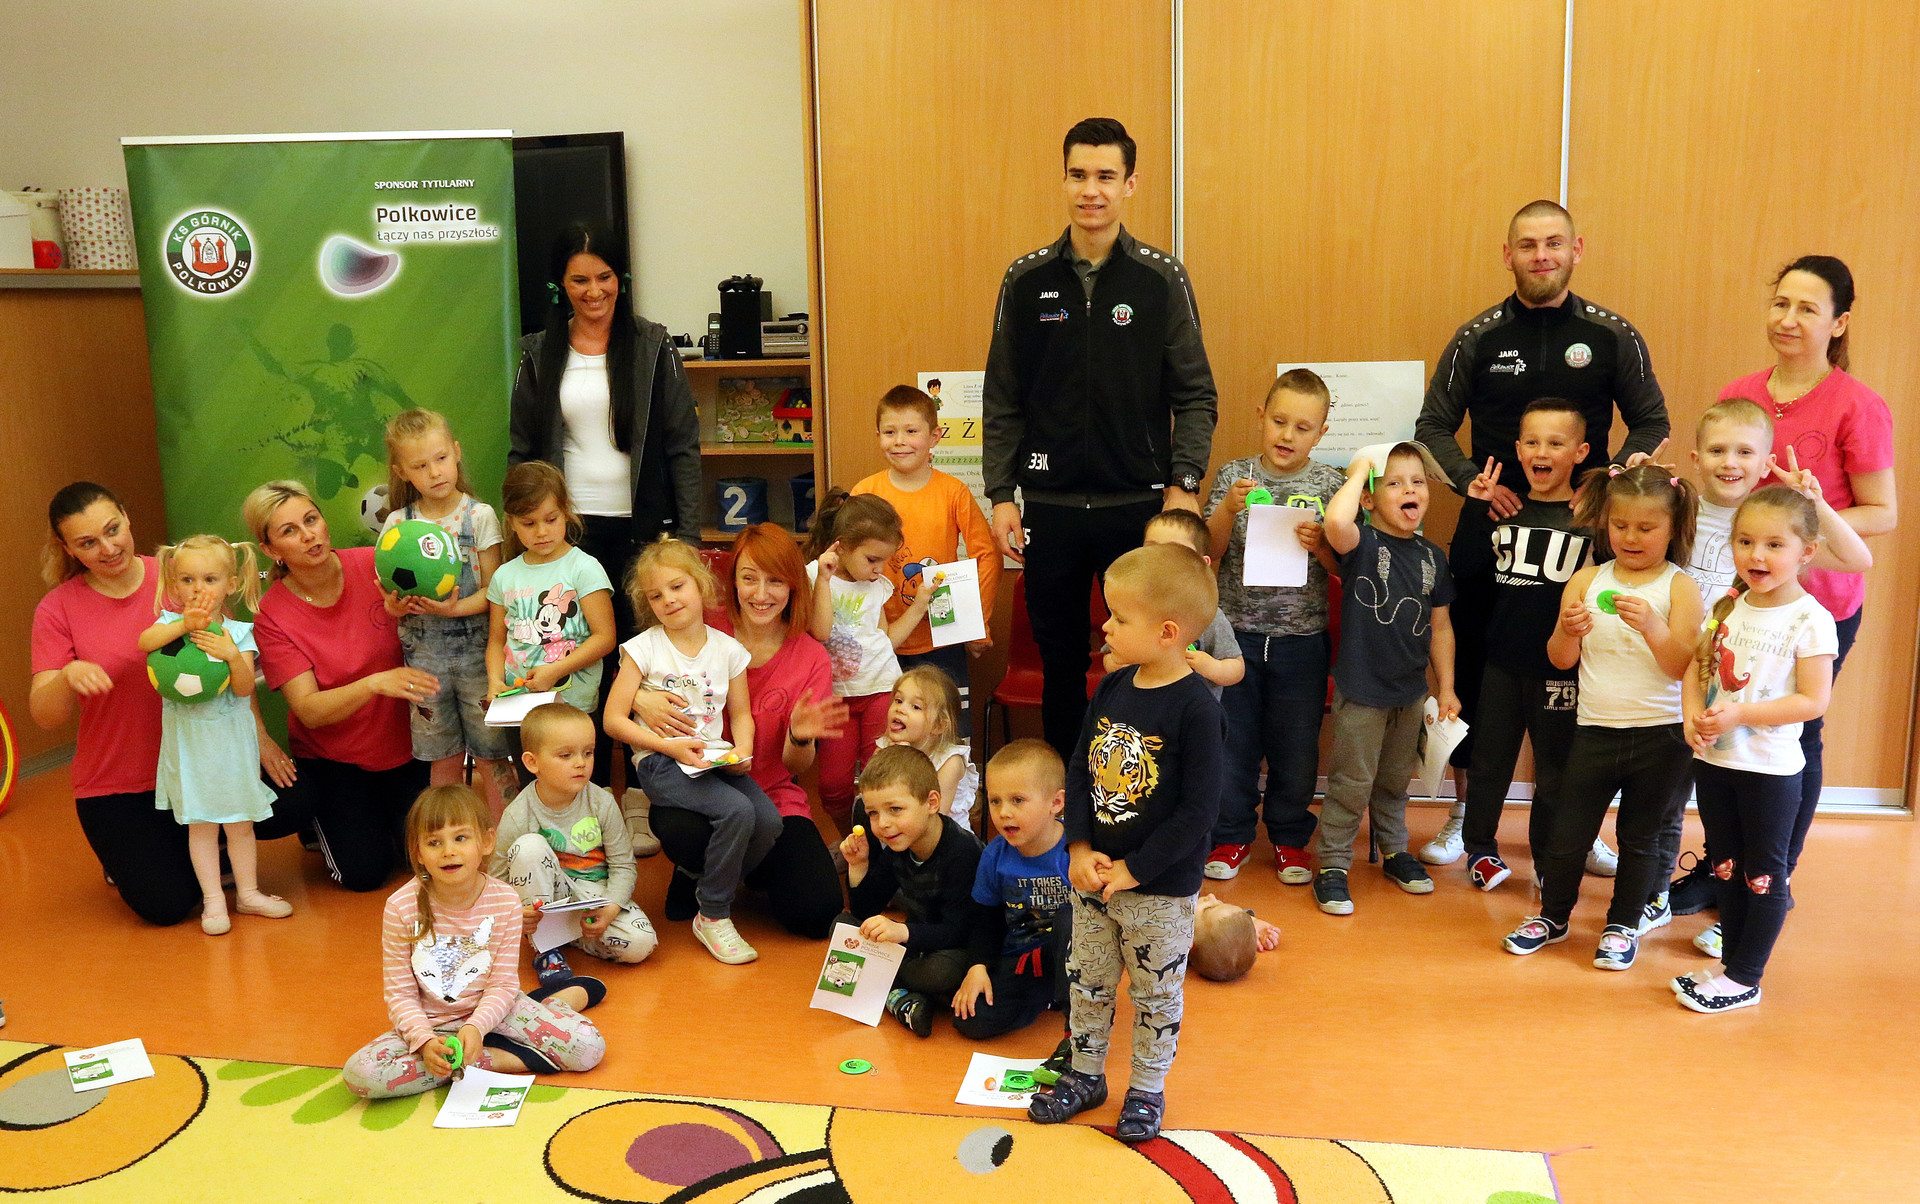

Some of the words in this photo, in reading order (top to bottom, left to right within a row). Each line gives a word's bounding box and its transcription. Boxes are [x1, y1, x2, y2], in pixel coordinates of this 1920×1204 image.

[374, 180, 419, 190] SPONSOR
[421, 179, 475, 188] TYTULARNY
[376, 204, 477, 223] Polkowice
[172, 225, 189, 243] KS
[190, 213, 243, 241] GÓRNIK
[377, 230, 409, 243] Łączy
[413, 230, 434, 240] nas
[438, 226, 498, 241] przyszłość
[172, 259, 248, 292] POLKOWICE
[1039, 291, 1059, 299] JAKO
[1498, 350, 1519, 358] JAKO
[962, 417, 976, 439] Ż
[1028, 452, 1049, 471] 33K
[723, 486, 748, 526] 2
[1022, 527, 1031, 546] 5
[1491, 525, 1586, 583] CLU
[1495, 573, 1509, 584] OYS
[1742, 621, 1771, 635] Never
[1546, 687, 1576, 706] 79
[1017, 878, 1028, 888] IT
[1030, 876, 1062, 887] TAKES
[1029, 895, 1044, 906] TO
[1047, 893, 1071, 905] FIGH
